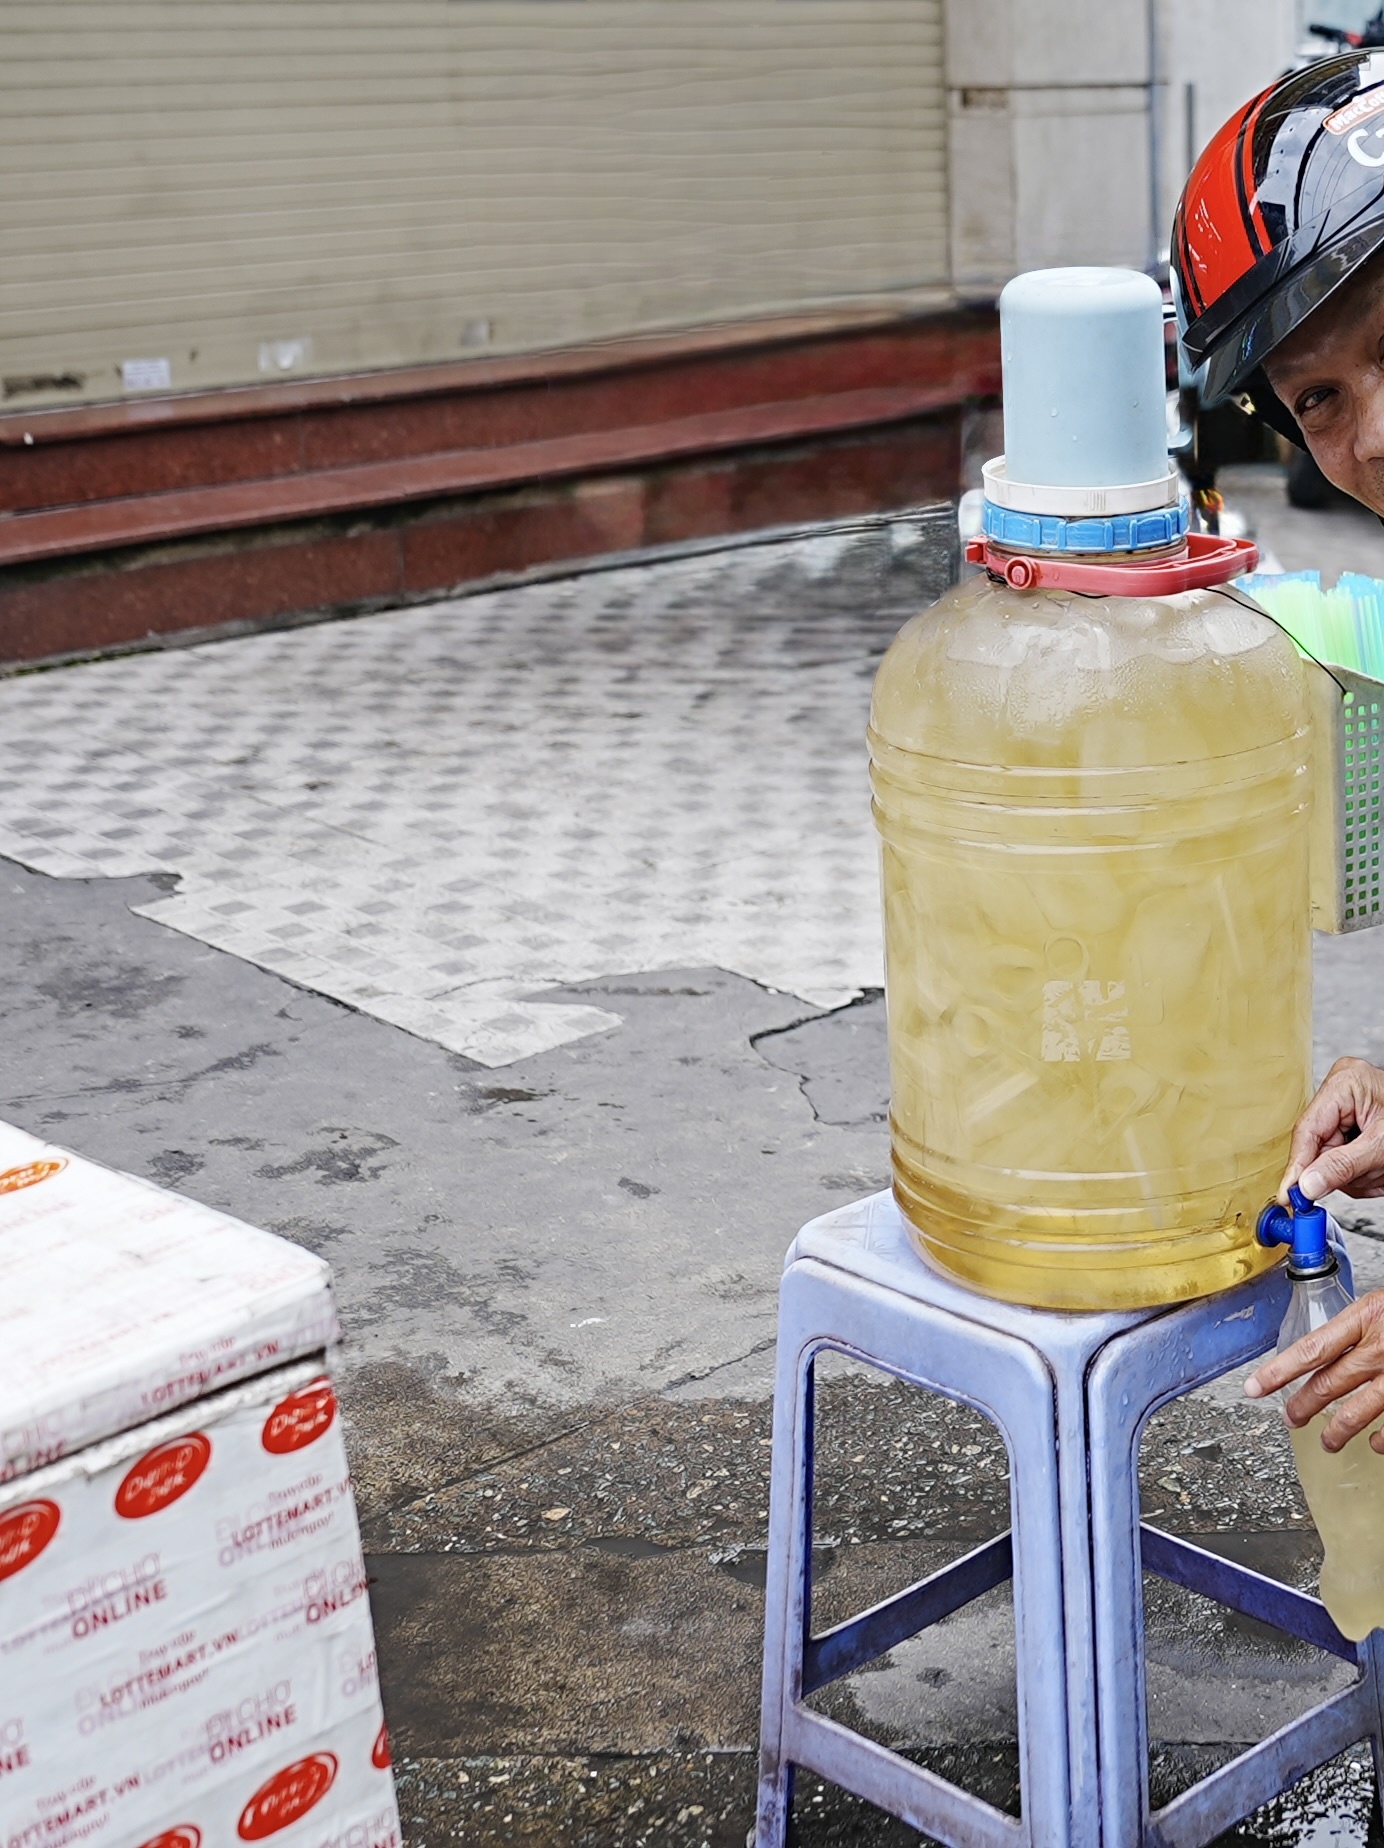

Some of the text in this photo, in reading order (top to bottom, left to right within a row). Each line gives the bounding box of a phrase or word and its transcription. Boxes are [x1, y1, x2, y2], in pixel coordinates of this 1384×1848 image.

[73, 1578, 168, 1640] ONLINE
[100, 1629, 238, 1708] LOTTEMART.VN
[209, 1702, 297, 1764] ONLINE
